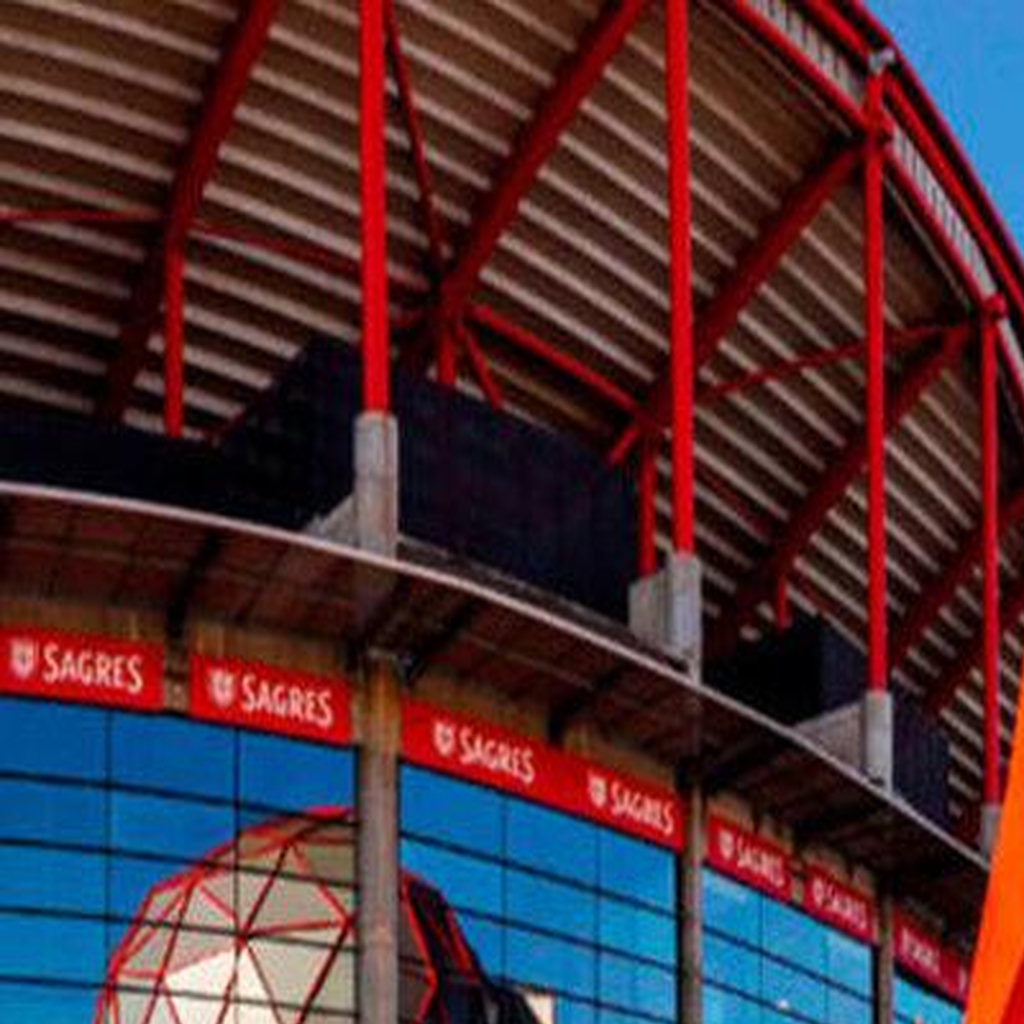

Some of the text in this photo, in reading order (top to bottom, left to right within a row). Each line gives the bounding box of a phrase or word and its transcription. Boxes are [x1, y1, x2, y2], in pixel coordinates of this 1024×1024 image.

[43, 644, 144, 694] SAGRES
[242, 674, 333, 728] SAGRES
[459, 725, 535, 784] SAGRES
[610, 781, 674, 835] SAGRES
